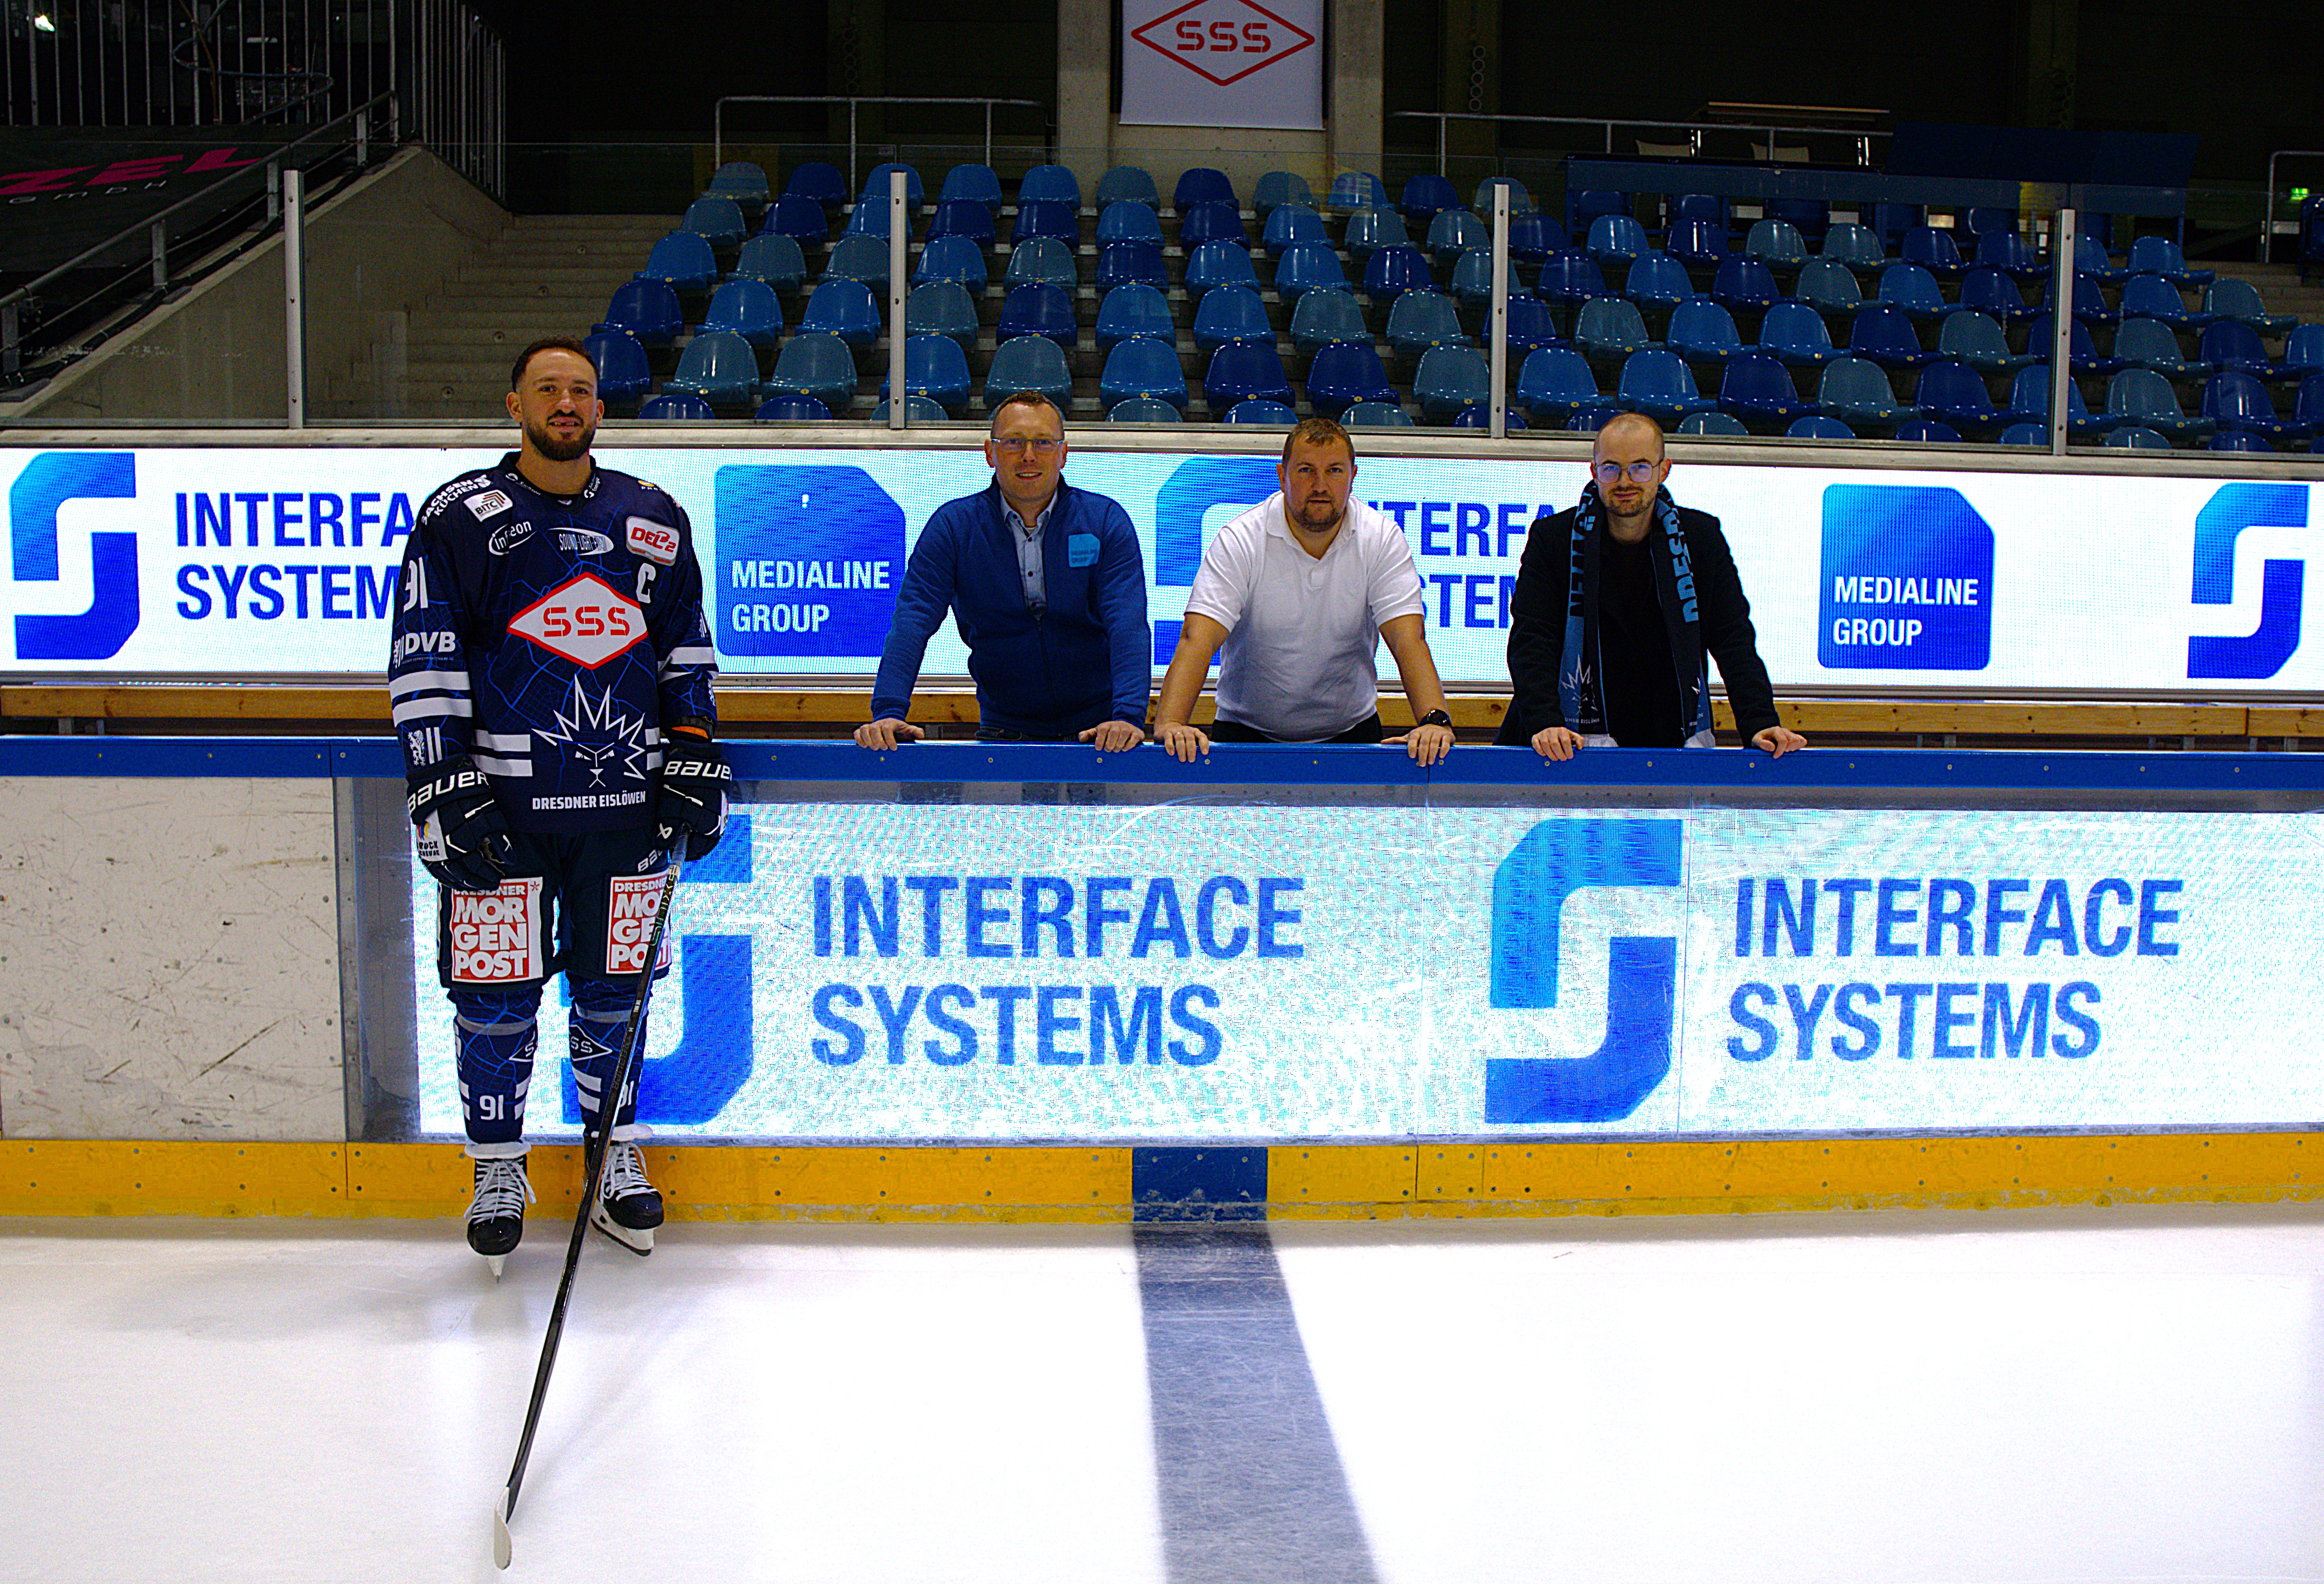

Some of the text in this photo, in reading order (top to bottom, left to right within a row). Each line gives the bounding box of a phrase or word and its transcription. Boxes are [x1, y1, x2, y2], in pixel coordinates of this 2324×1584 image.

[1176, 21, 1271, 53] SSS
[421, 480, 474, 526] SACHSEN
[434, 483, 479, 516] KÜCHEN
[475, 501, 497, 514] BITC
[403, 557, 428, 613] 91
[636, 562, 656, 604] C
[732, 561, 890, 589] MEDIALINE
[1834, 576, 1979, 605] MEDIALINE
[543, 606, 630, 637] SSS
[732, 603, 830, 632] GROUP
[1833, 618, 1923, 646] GROUP
[405, 632, 455, 655] DVB
[664, 761, 732, 781] BAUE
[532, 790, 646, 810] DRESDNER EISLÖWEN
[453, 897, 526, 924] MOR
[613, 889, 664, 919] MO
[812, 875, 1305, 958] INTERFACE
[1735, 878, 2184, 956] INTERFACE
[454, 923, 527, 951] GEN
[455, 949, 527, 978] POST
[810, 983, 1222, 1066] SYSTEMS
[1727, 981, 2102, 1061] SYSTEMS
[569, 1035, 593, 1054] SS
[479, 1094, 504, 1120] 91
